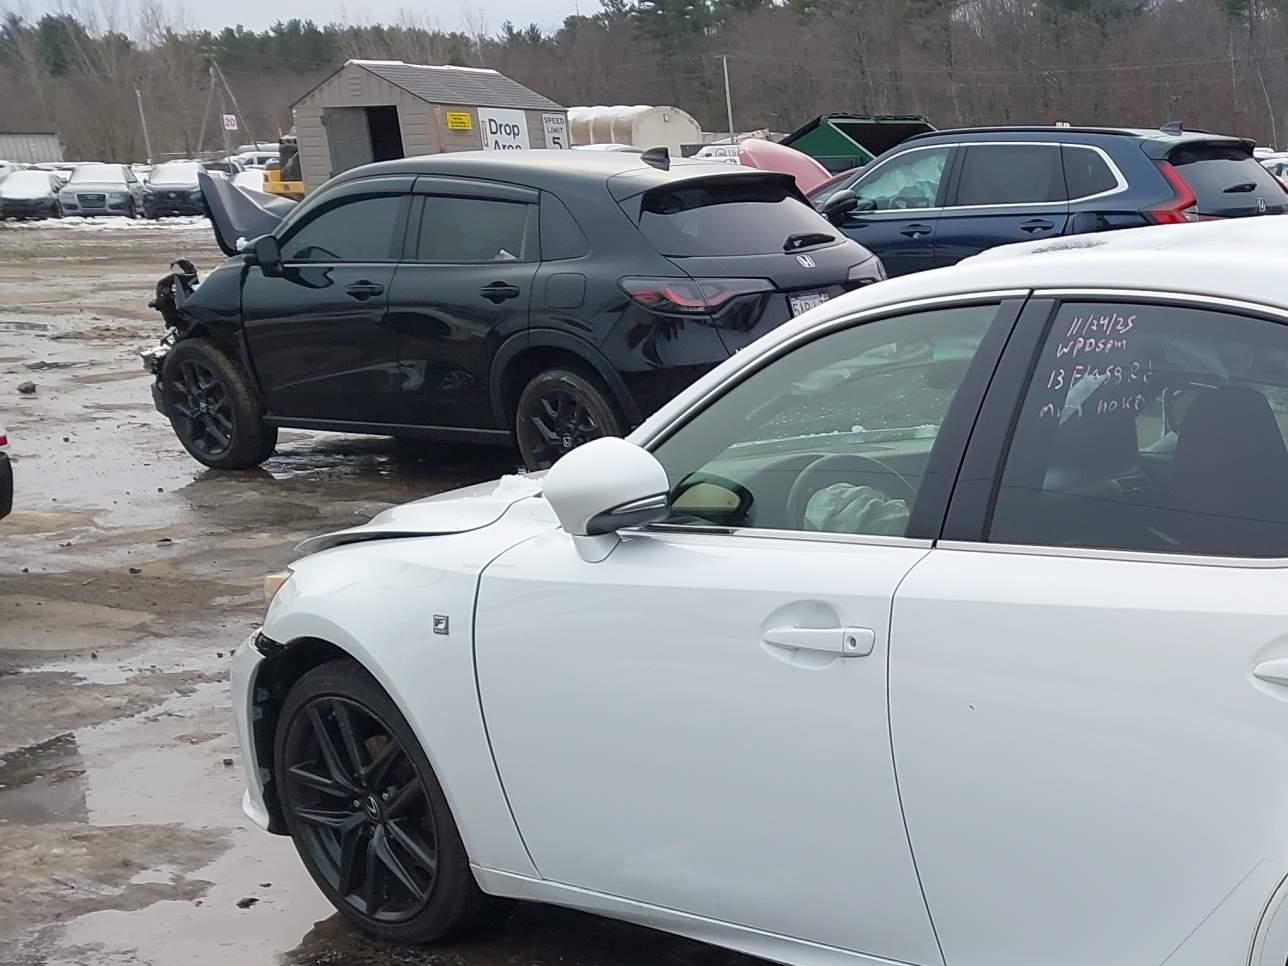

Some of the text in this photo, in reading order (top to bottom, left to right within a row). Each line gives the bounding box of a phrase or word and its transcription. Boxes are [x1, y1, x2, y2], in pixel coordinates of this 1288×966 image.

[543, 116, 564, 124] SPEED
[488, 118, 520, 140] Drop
[546, 126, 563, 134] LIMIT
